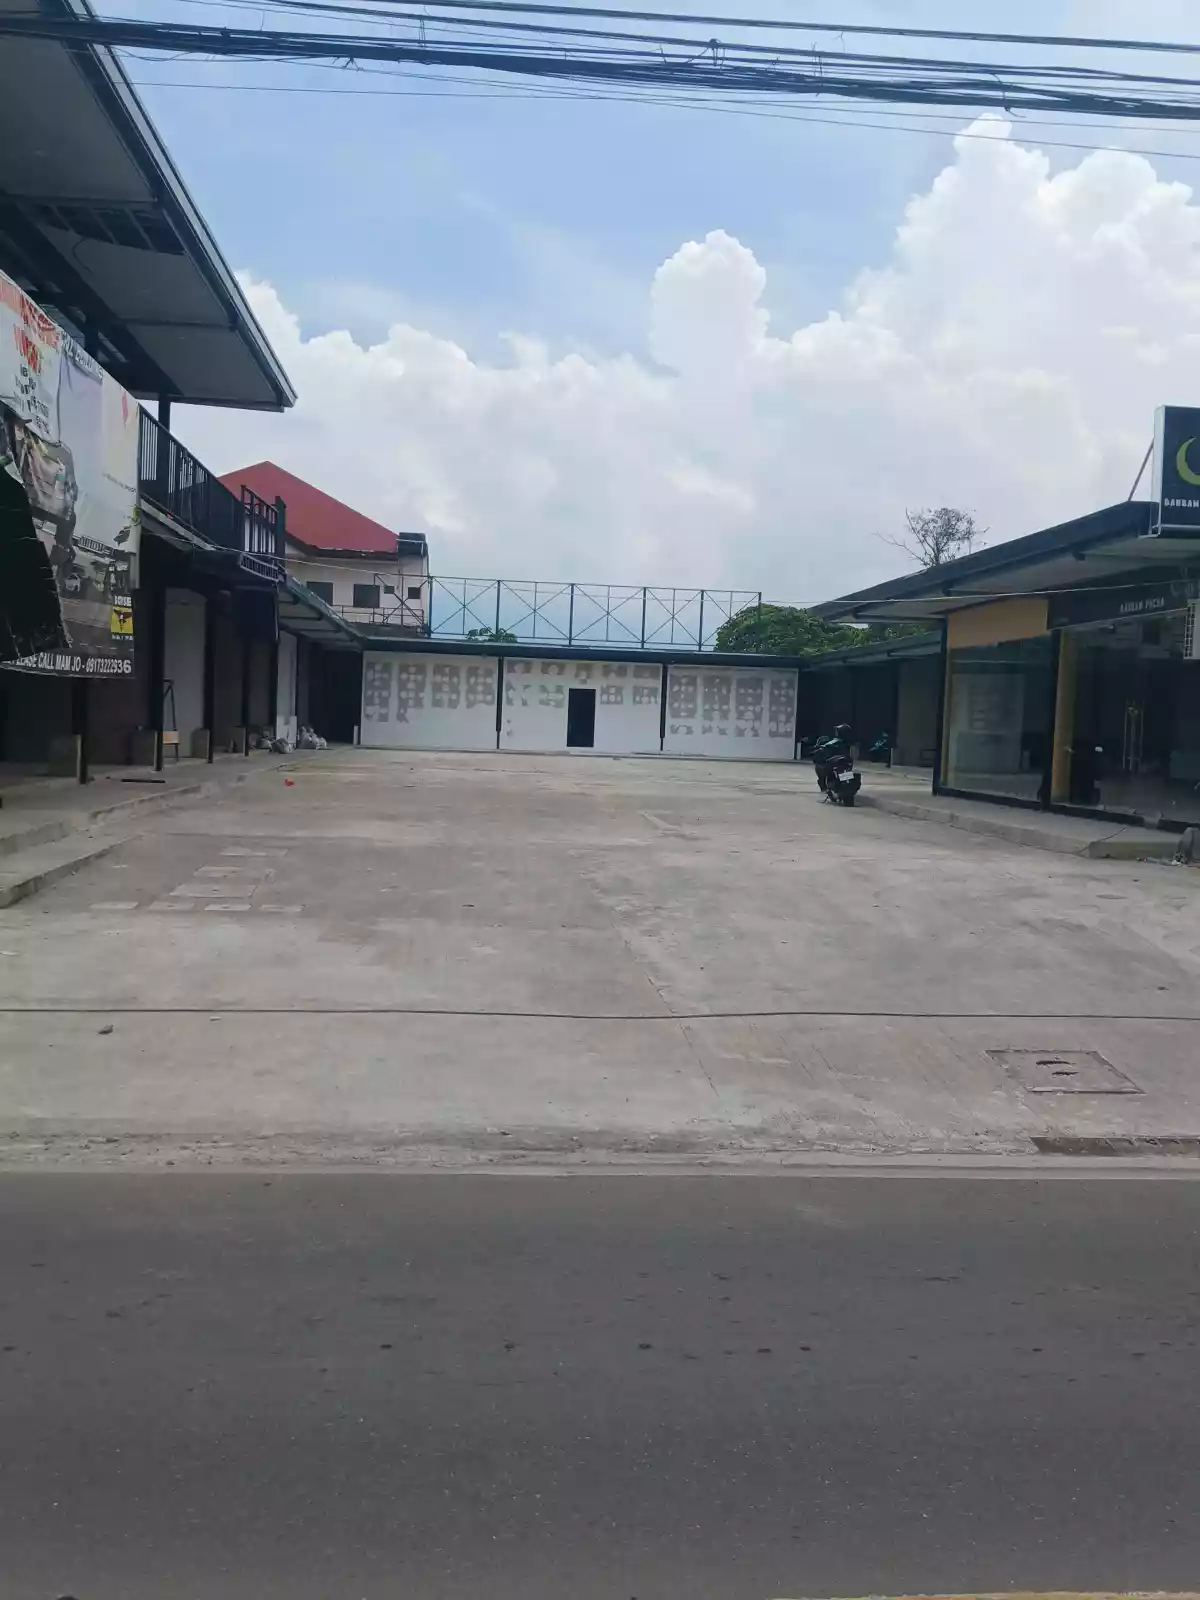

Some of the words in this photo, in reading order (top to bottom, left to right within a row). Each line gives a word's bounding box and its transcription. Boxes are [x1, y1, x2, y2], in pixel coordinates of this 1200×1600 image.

[38, 651, 54, 669] CALL
[55, 654, 71, 670] MAM
[71, 656, 81, 672] JO
